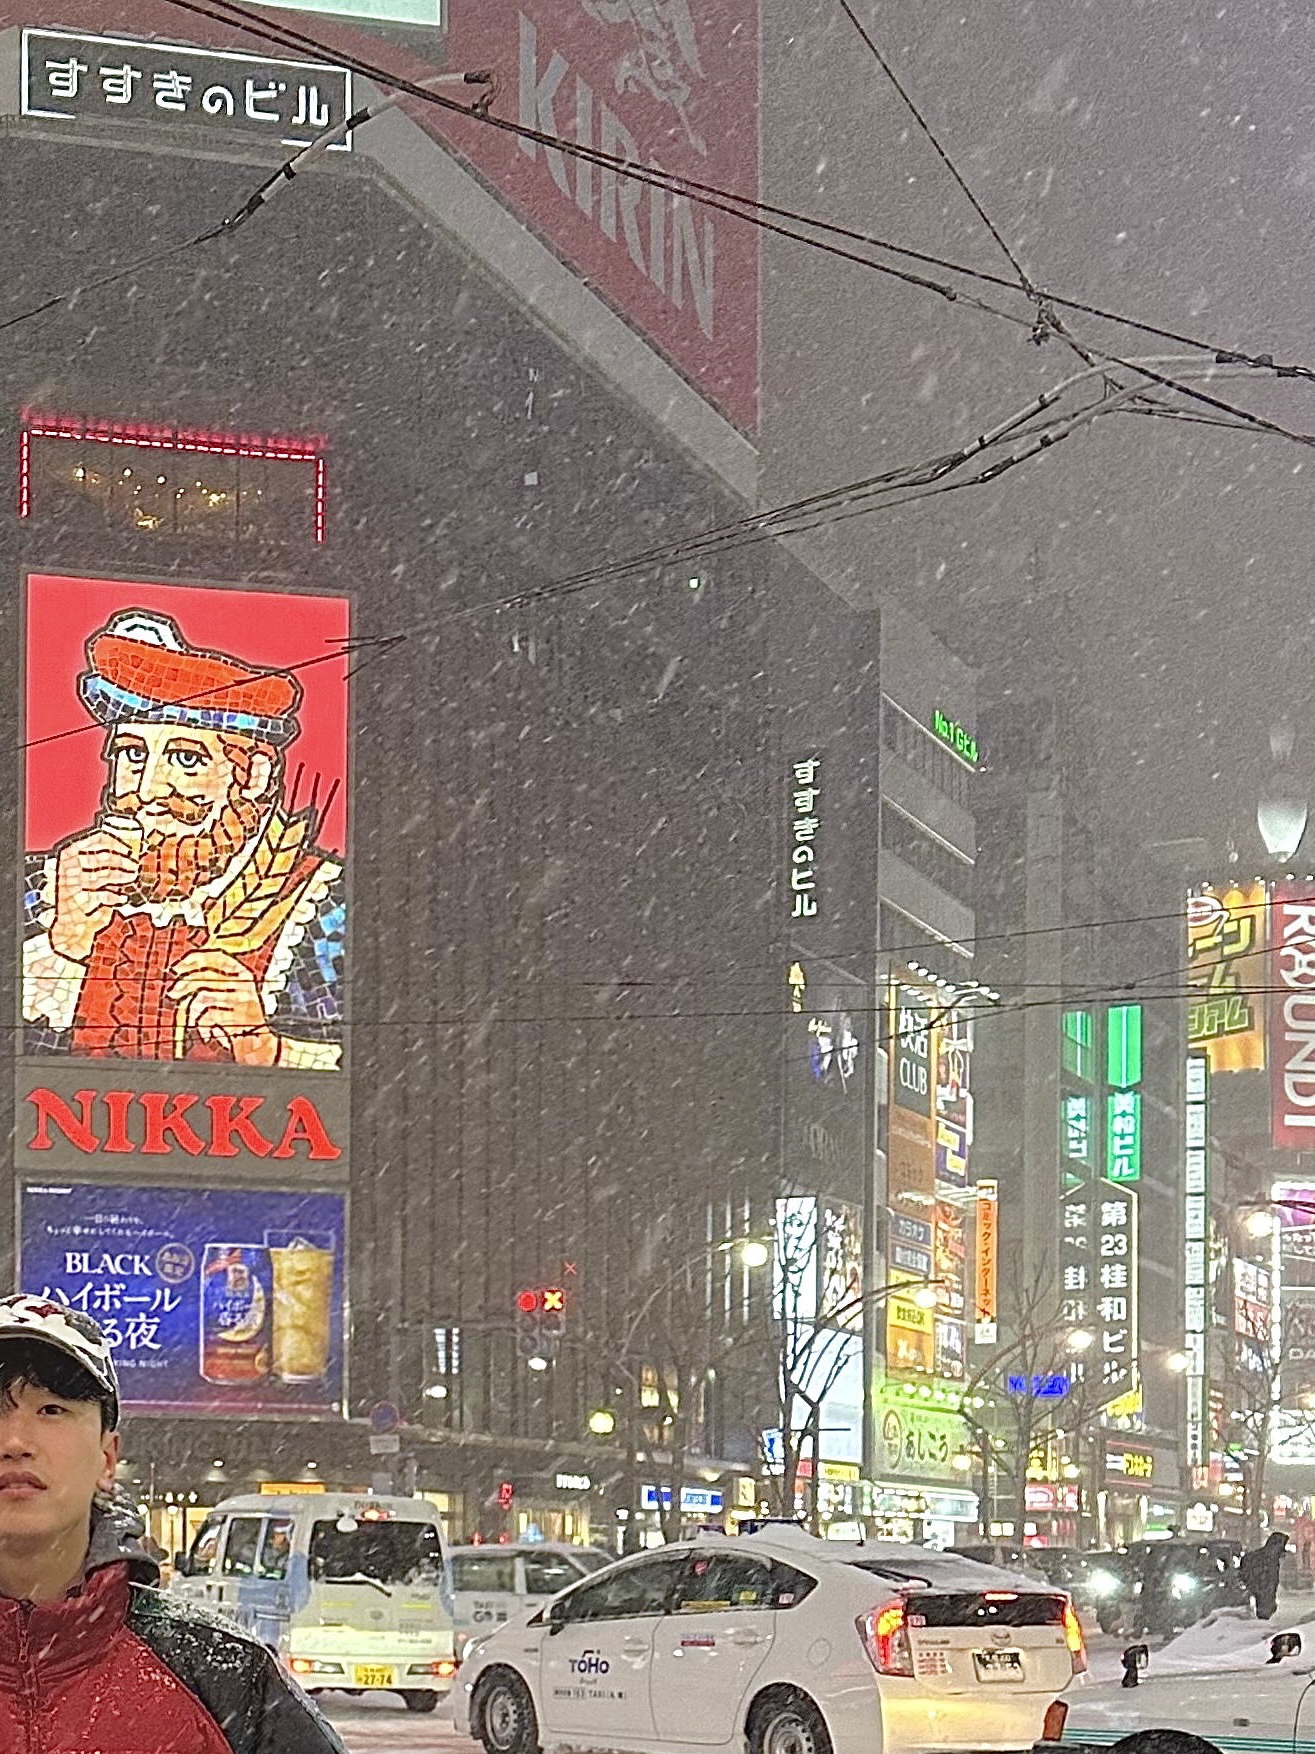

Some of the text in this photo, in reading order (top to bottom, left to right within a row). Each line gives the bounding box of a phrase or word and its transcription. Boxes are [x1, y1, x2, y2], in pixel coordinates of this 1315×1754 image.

[45, 57, 329, 127] すすきのビル
[519, 10, 715, 343] KIRIN
[791, 759, 820, 918] すすきのビル
[900, 1057, 927, 1095] CLUB
[26, 1088, 342, 1160] NIKKA
[66, 1252, 152, 1277] BLACK
[42, 1281, 182, 1313] ハイボール
[1097, 1200, 1128, 1385] 第23桂和ビル
[102, 1312, 162, 1350] る夜
[364, 1674, 393, 1686] 27-74
